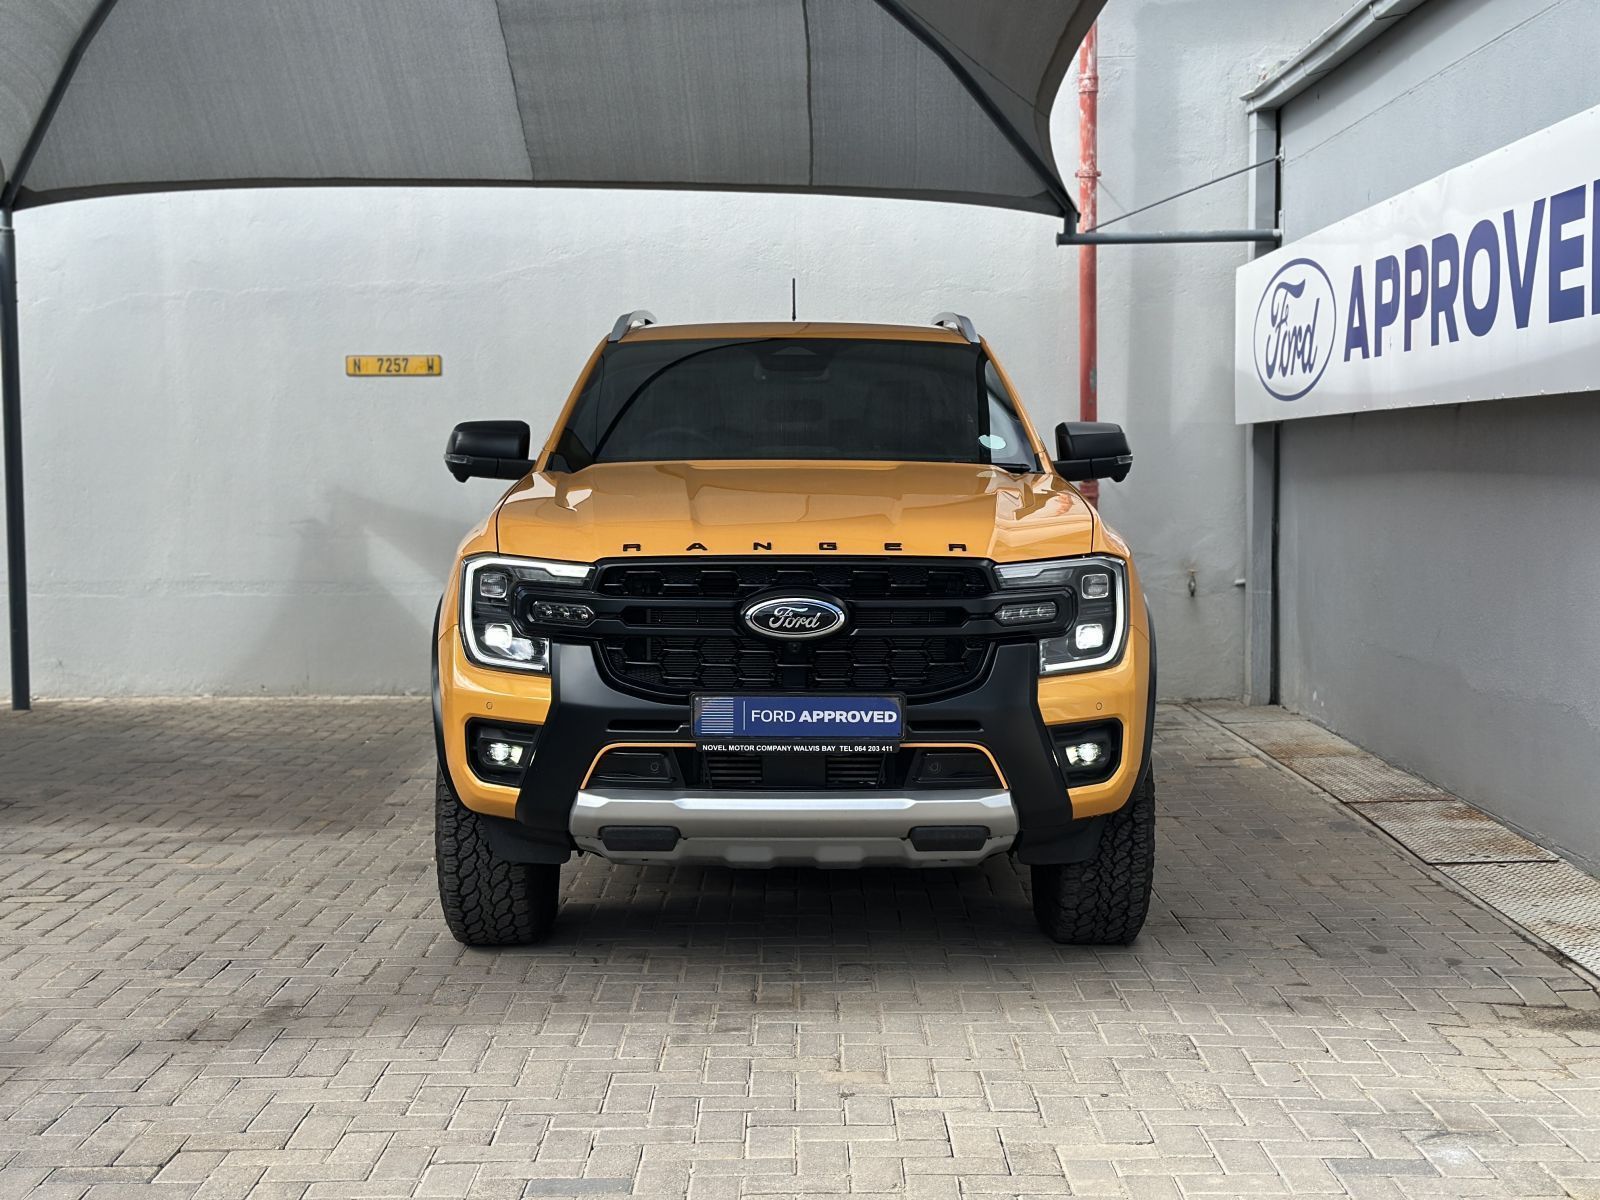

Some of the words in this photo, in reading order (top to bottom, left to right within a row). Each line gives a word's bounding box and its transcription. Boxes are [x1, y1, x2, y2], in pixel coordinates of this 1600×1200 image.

[1265, 278, 1321, 380] Ford
[1343, 178, 1600, 363] APPROVE
[353, 358, 361, 373] N
[376, 358, 409, 373] 7257
[426, 357, 434, 373] W
[622, 542, 967, 551] RANGER
[768, 606, 821, 630] Ford
[751, 709, 796, 723] FORD
[799, 710, 898, 723] APPROVED
[702, 744, 728, 752] NOVEL
[728, 744, 755, 752] MOTOR
[756, 744, 792, 752] COMPANY
